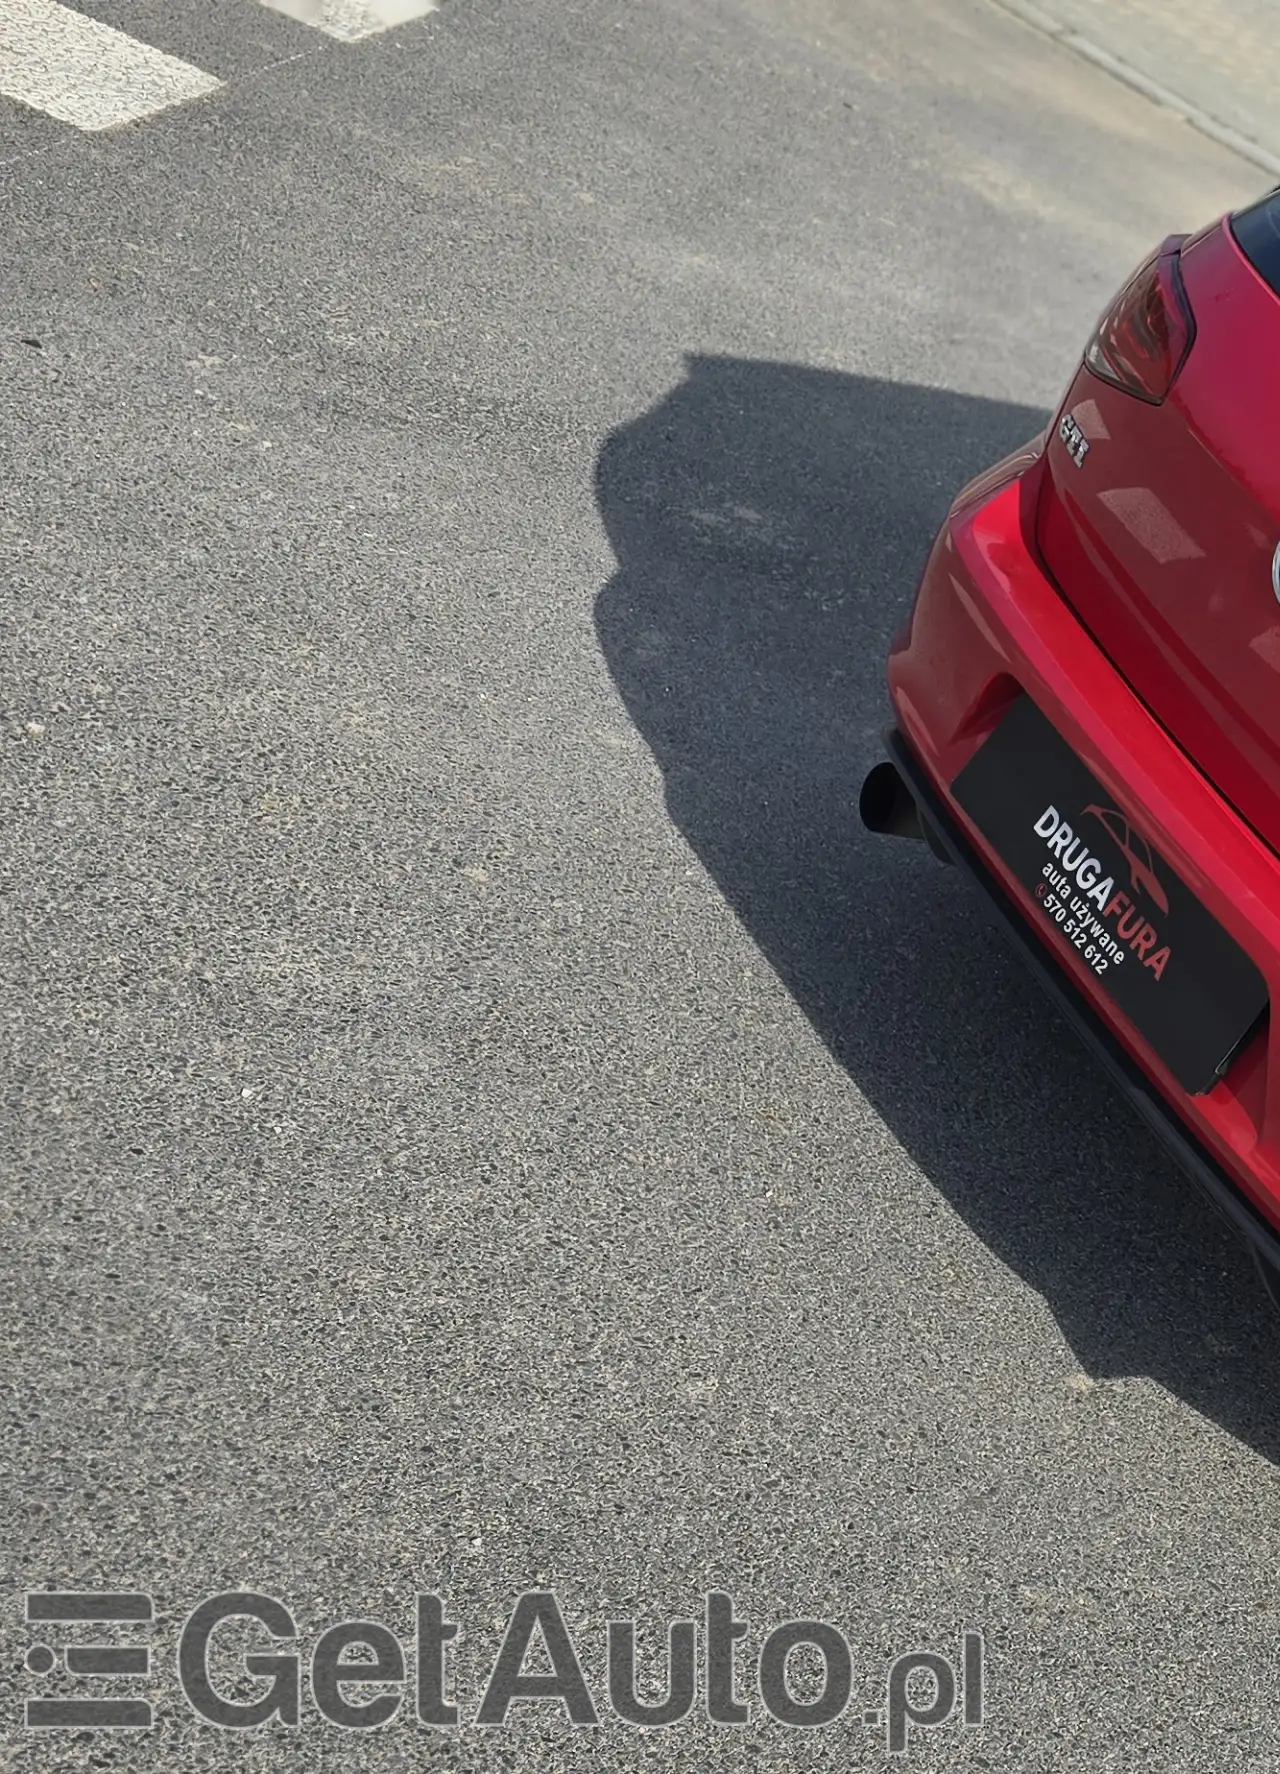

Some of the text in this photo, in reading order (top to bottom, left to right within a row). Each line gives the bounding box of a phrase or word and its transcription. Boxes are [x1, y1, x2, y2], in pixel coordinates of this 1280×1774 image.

[1060, 414, 1090, 469] GTI
[1042, 862, 1125, 965] auta używane
[1043, 893, 1109, 975] 570 512 612
